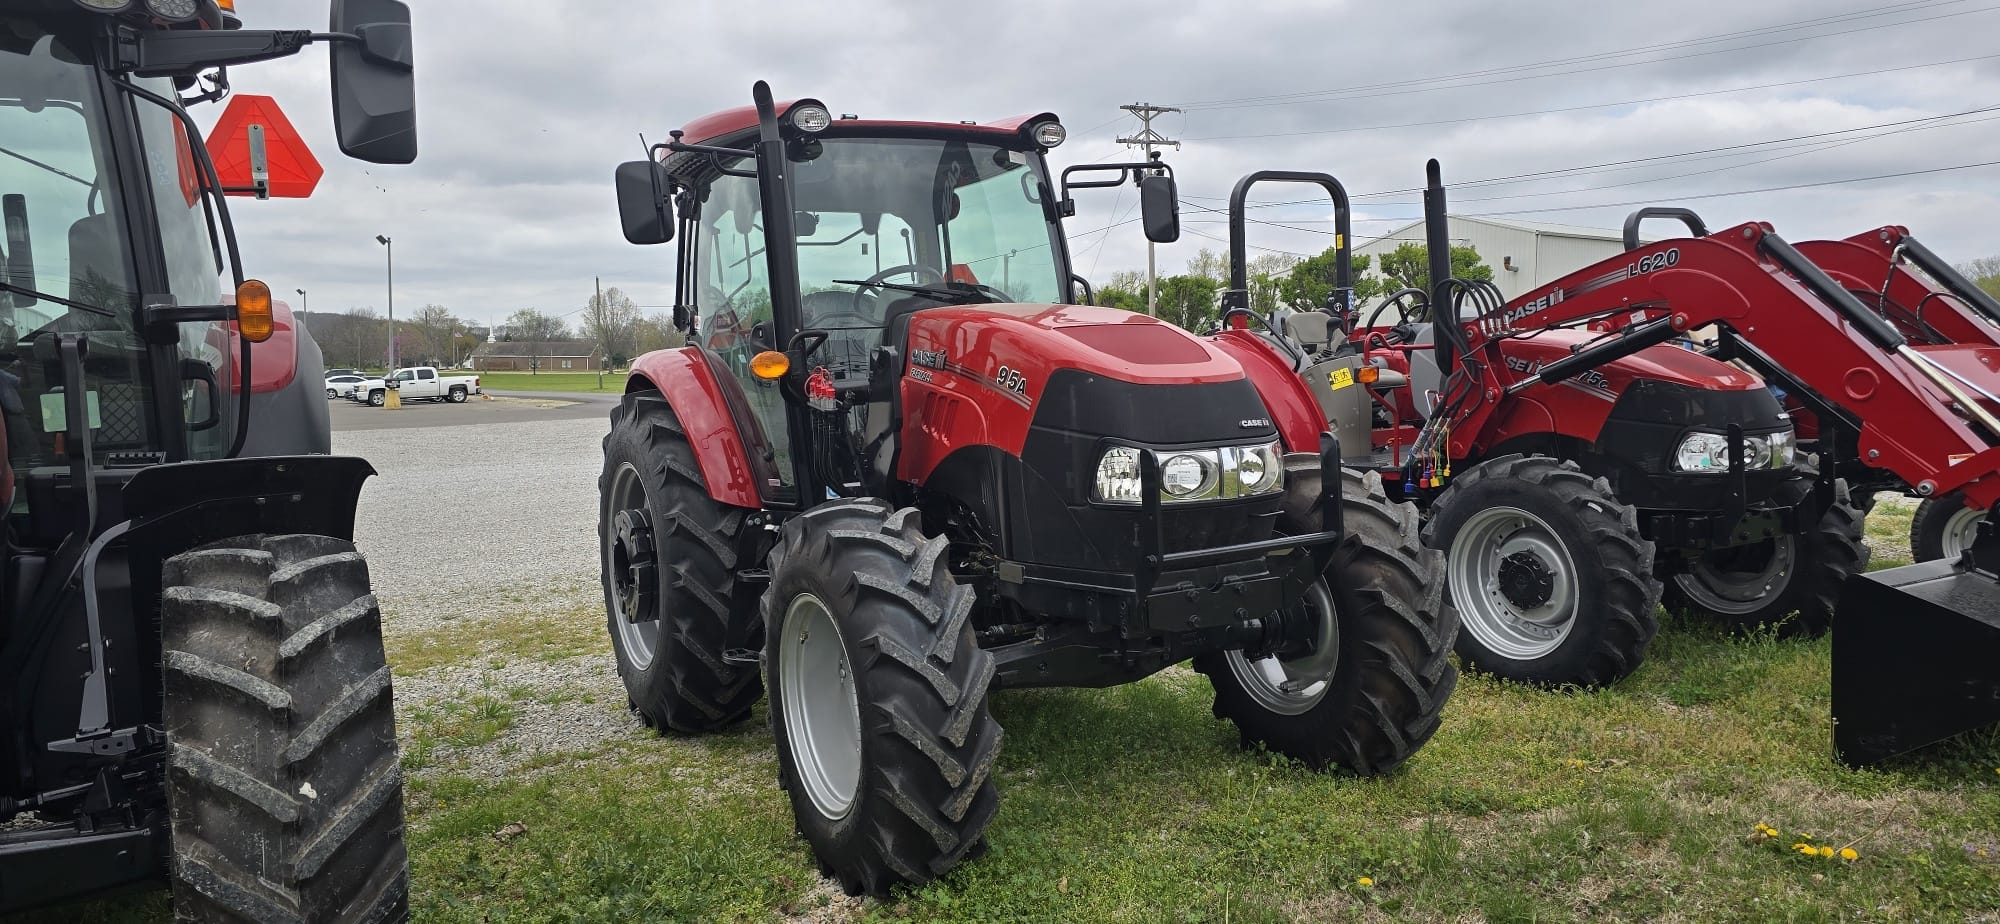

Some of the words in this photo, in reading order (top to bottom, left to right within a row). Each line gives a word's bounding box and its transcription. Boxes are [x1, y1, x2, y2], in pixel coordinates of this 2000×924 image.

[1628, 248, 1680, 279] L620
[1505, 296, 1547, 323] CASE
[911, 349, 935, 366] CASE
[997, 366, 1027, 395] 95A
[1241, 419, 1262, 427] CASE
